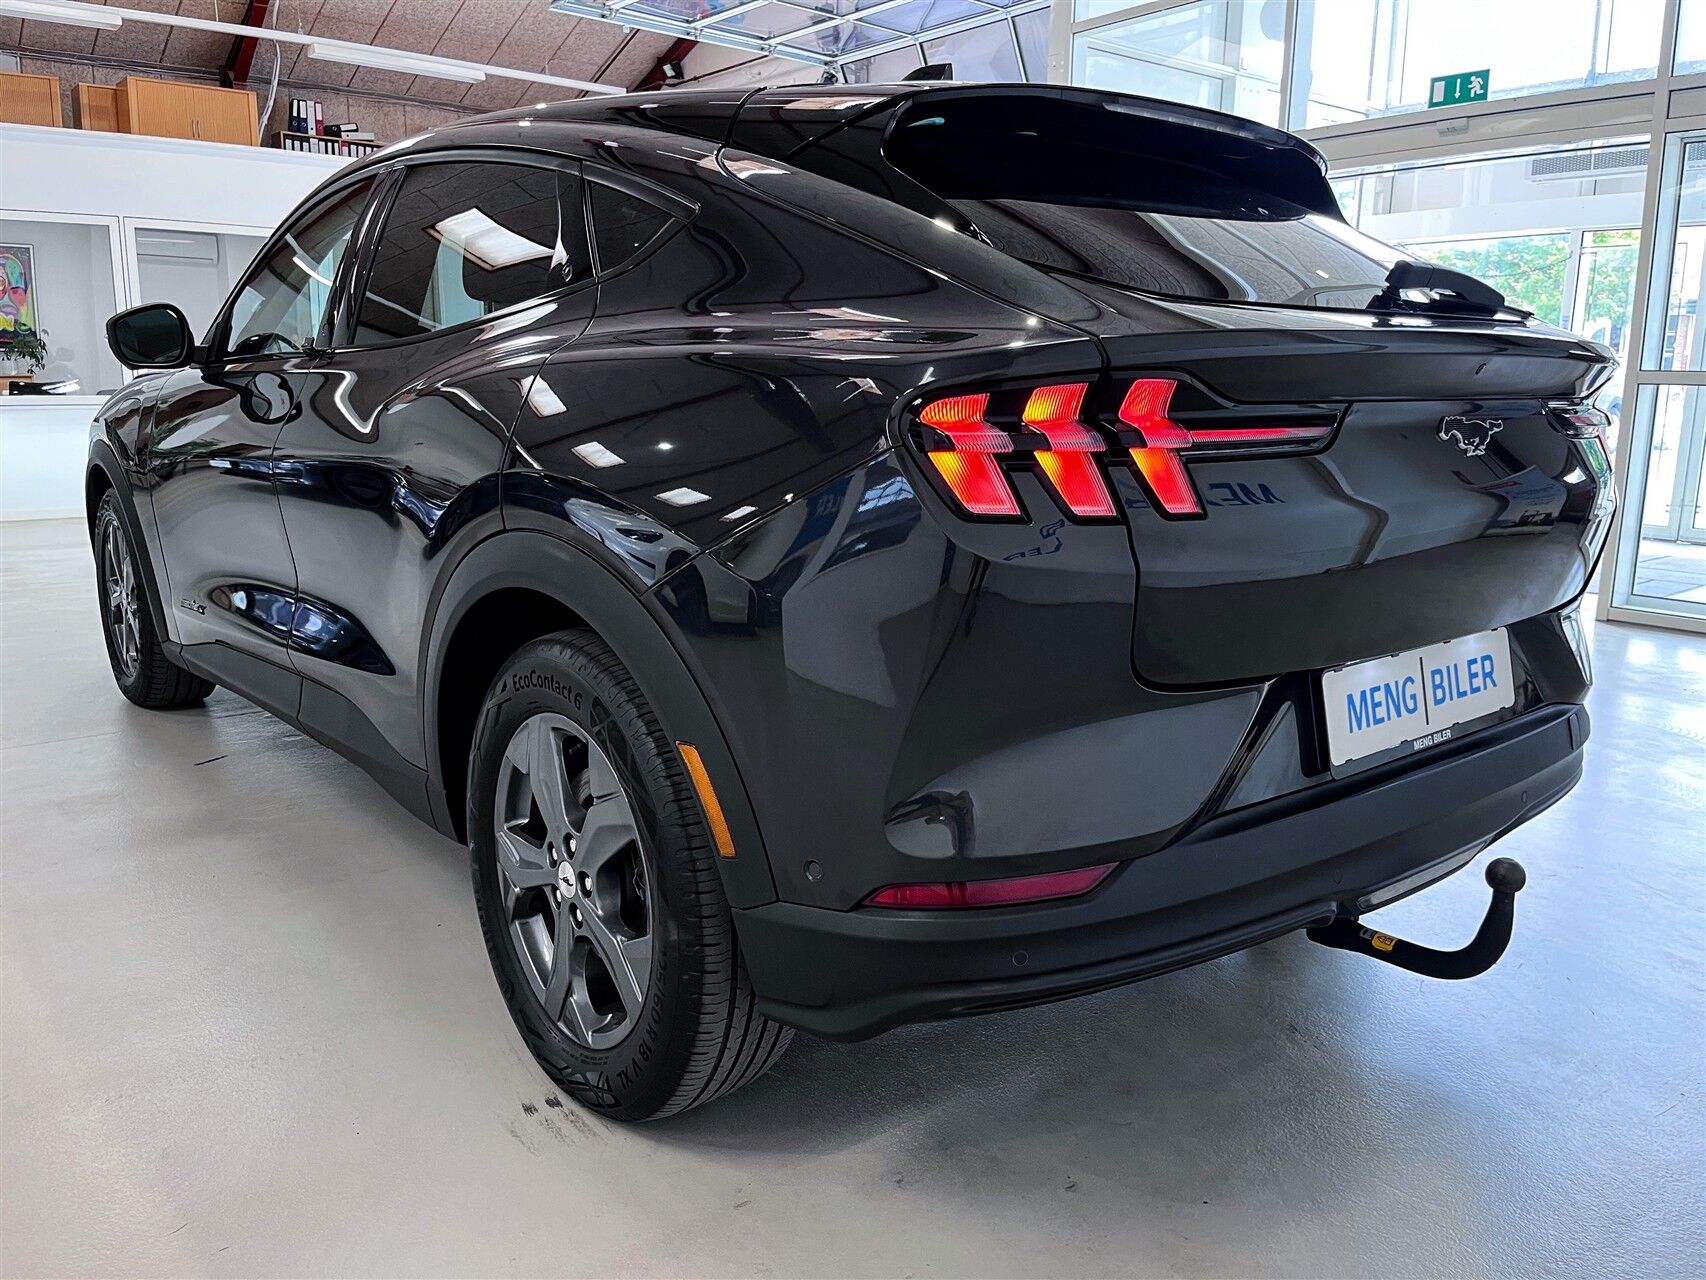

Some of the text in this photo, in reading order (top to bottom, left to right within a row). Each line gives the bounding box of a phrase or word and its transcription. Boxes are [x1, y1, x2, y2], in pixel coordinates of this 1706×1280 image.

[512, 669, 583, 711] EcoContact 6
[1346, 654, 1498, 734] MENG BILER
[1413, 729, 1452, 750] MENG BILER
